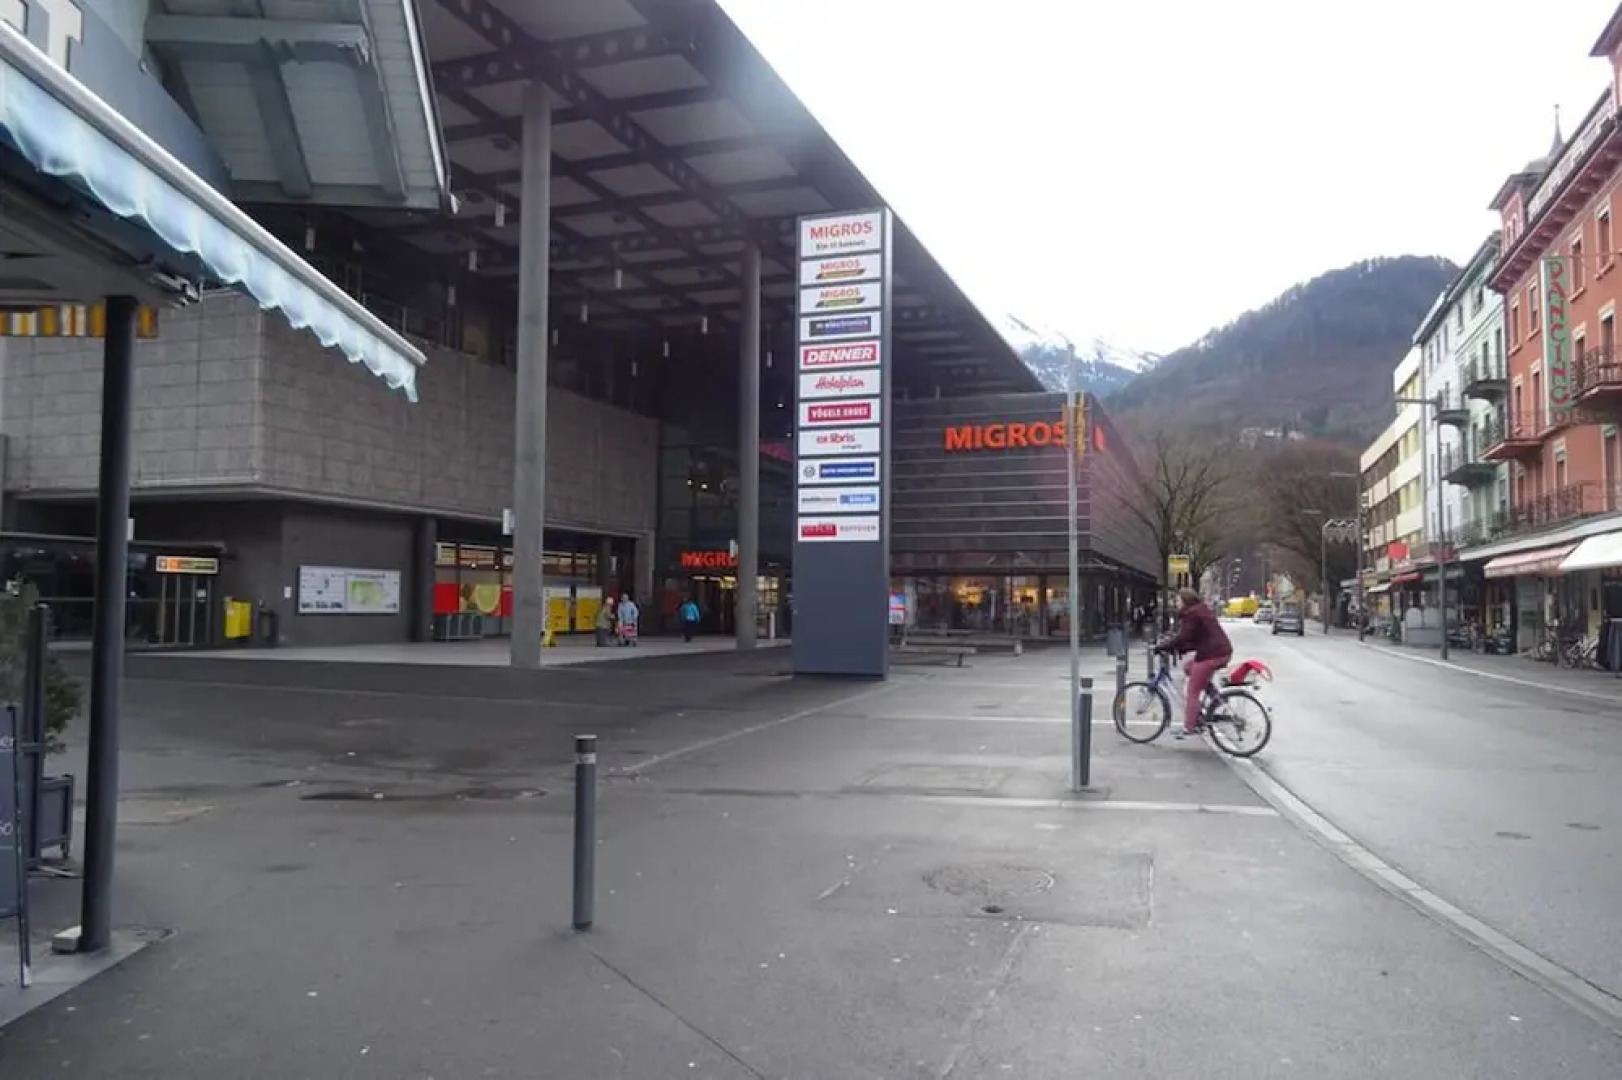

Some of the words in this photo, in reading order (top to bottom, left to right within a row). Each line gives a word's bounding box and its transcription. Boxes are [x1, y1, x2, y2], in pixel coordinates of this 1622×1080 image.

[810, 220, 873, 240] MIGROS
[820, 259, 860, 270] MIGROS
[820, 287, 860, 298] MIGROS
[1548, 260, 1569, 404] DANCING
[806, 347, 873, 364] DENNER
[944, 421, 1066, 452] MIGROS
